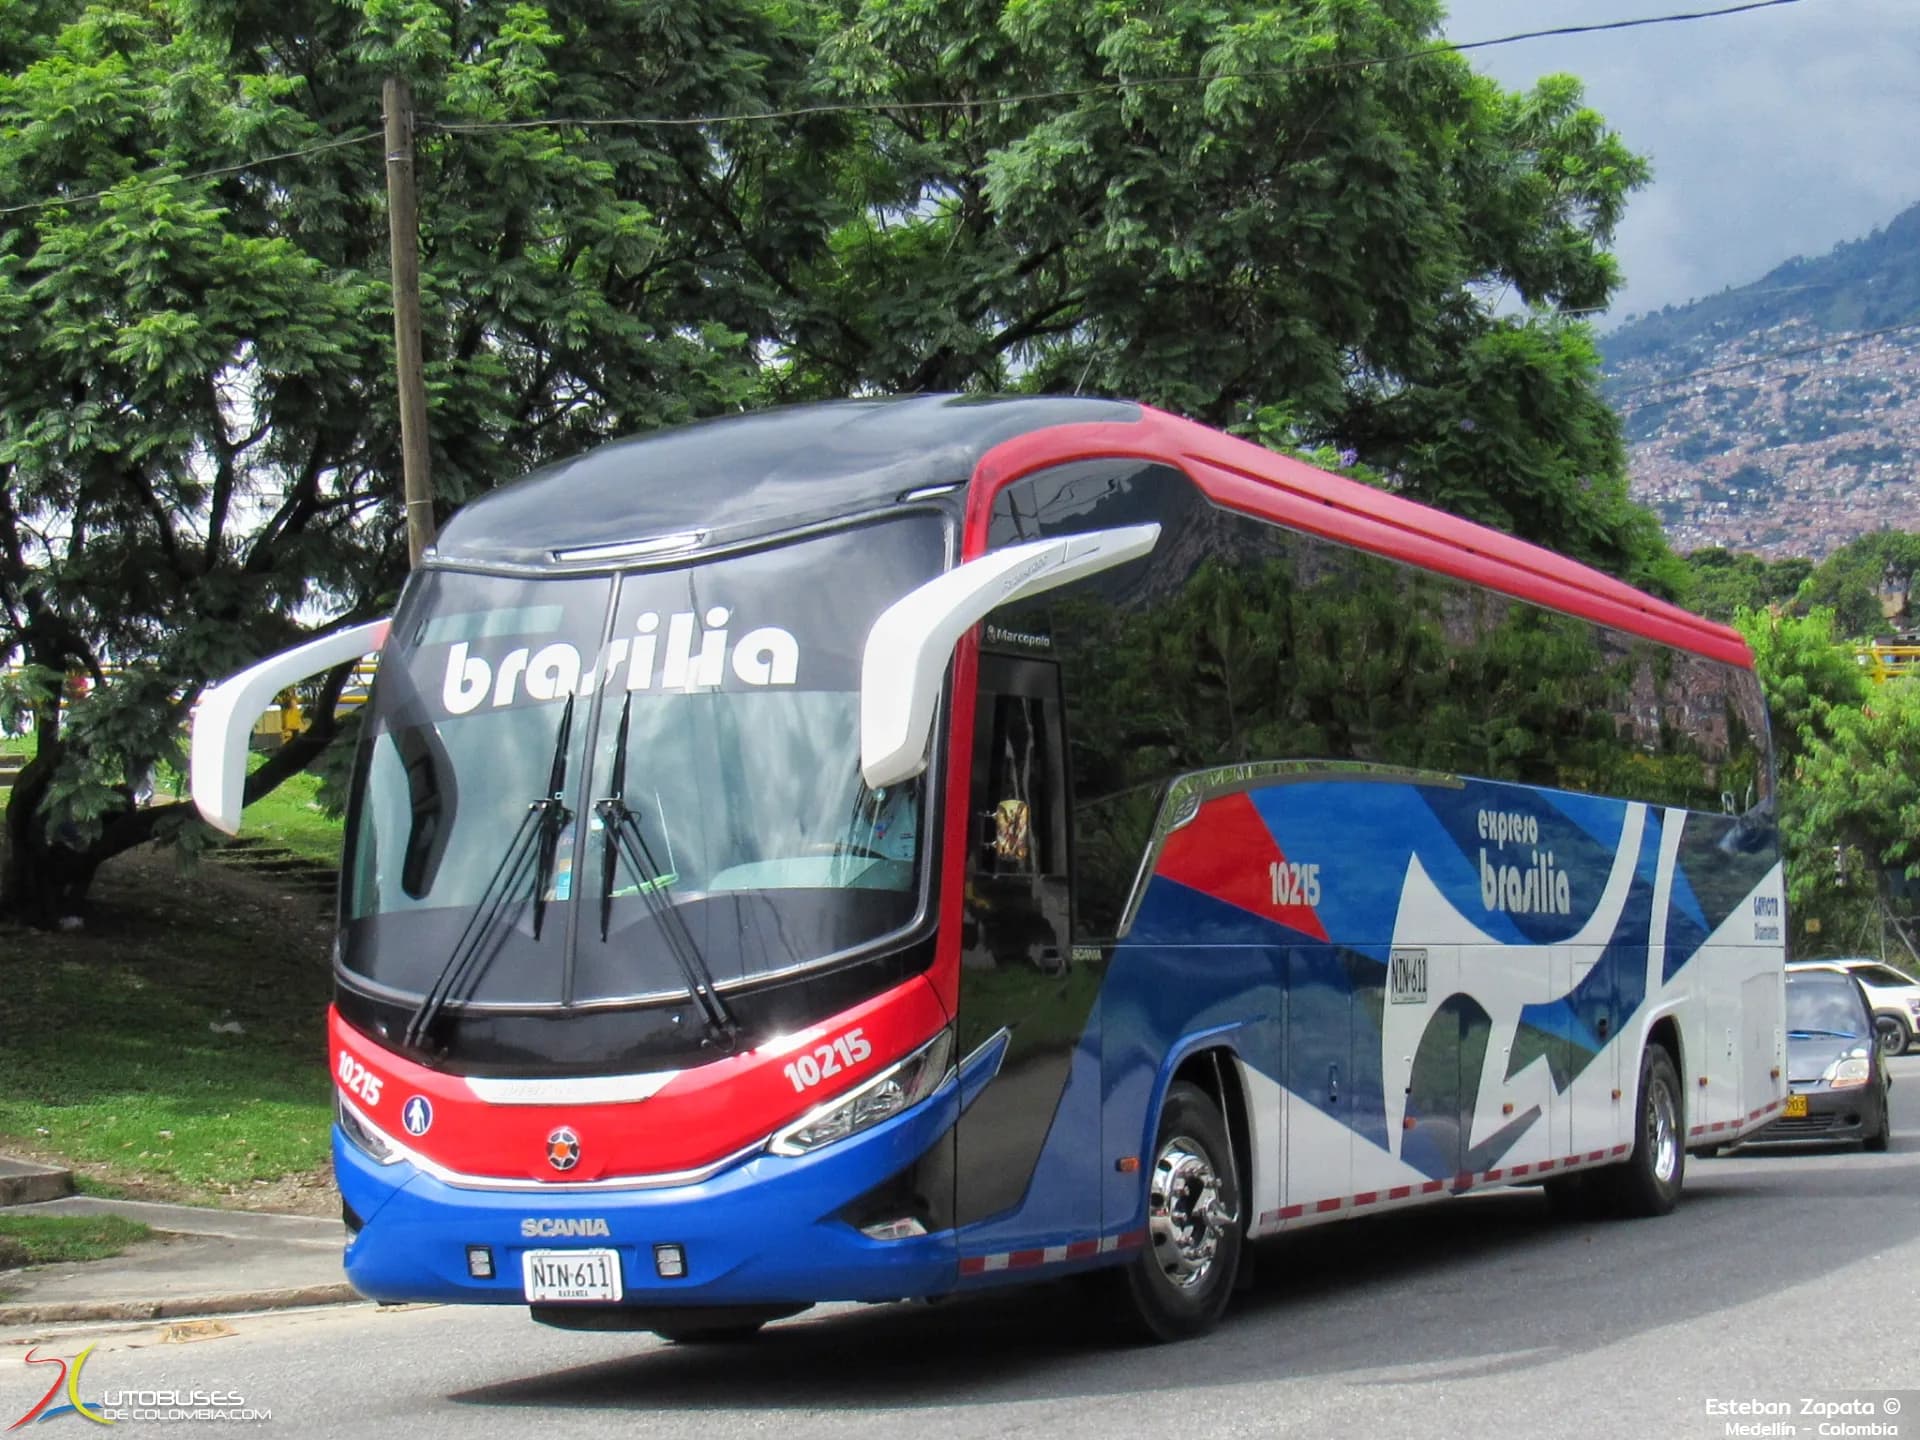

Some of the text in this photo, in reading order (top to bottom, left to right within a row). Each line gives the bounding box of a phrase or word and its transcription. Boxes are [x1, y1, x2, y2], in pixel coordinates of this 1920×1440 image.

[996, 629, 1051, 648] Marcopolo
[1478, 808, 1539, 850] expreso
[1269, 861, 1321, 907] 10215
[1479, 847, 1571, 915] brasilia
[338, 1050, 384, 1106] 10215
[784, 1027, 872, 1093] 10215
[521, 1218, 611, 1237] SCANIA
